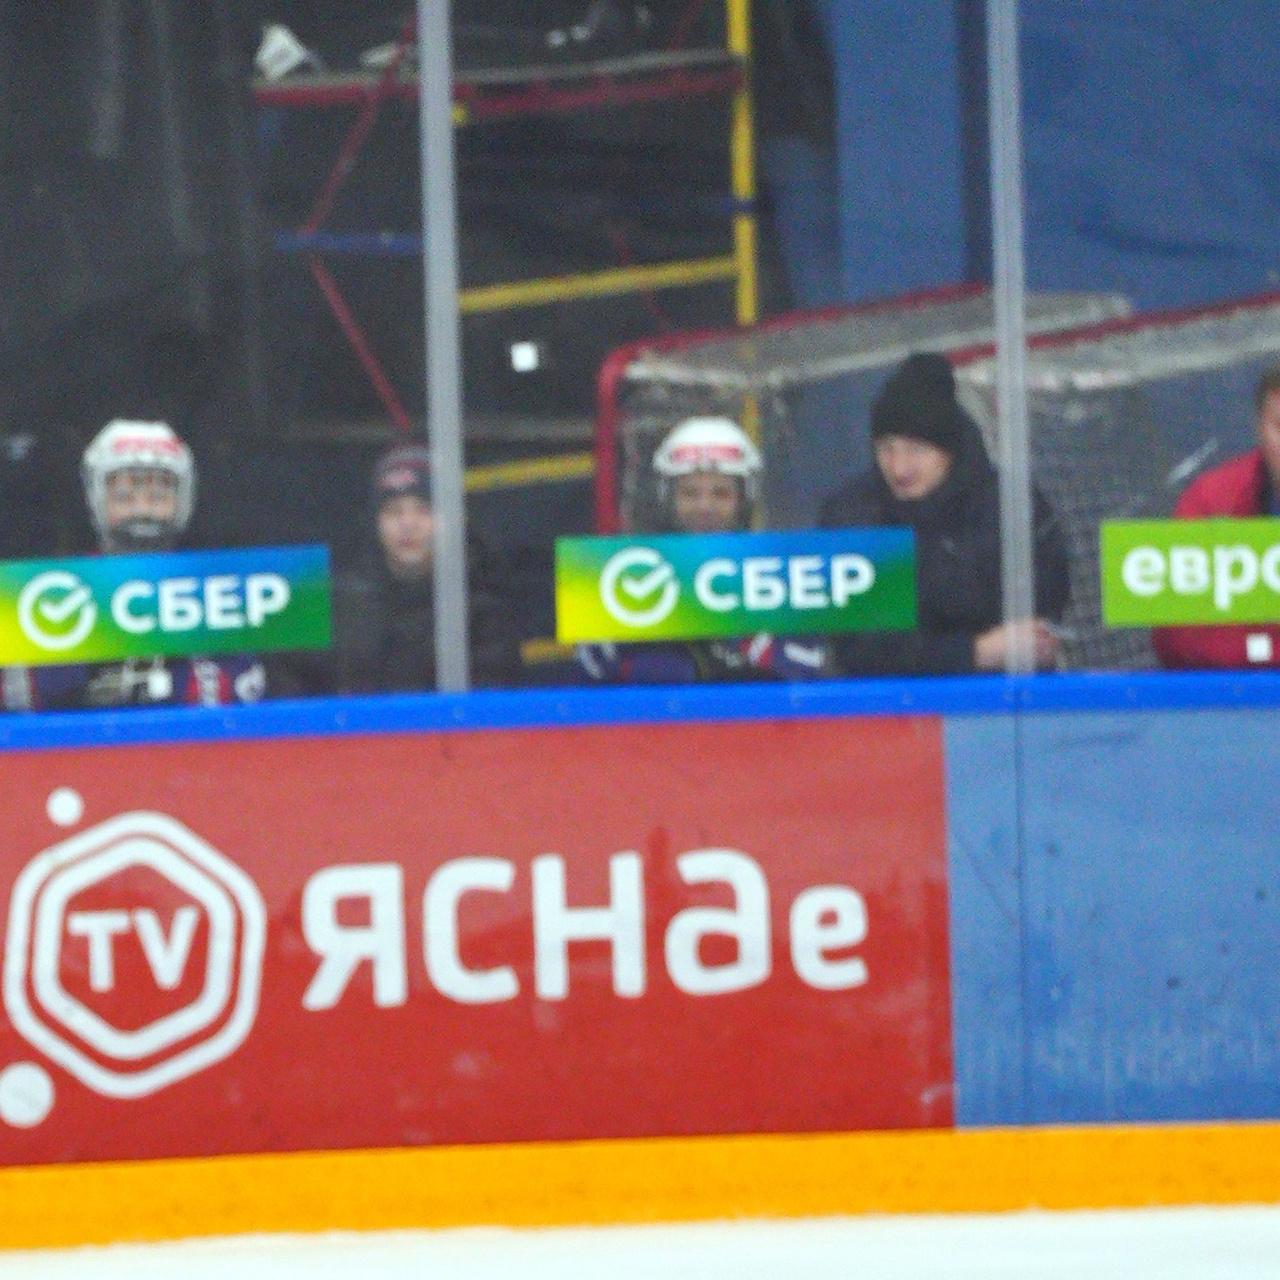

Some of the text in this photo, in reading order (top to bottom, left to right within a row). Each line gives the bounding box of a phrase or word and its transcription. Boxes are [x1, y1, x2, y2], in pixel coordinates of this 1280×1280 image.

[111, 572, 291, 634] СБЕР
[694, 553, 876, 612] СБЕР
[67, 907, 200, 992] TV
